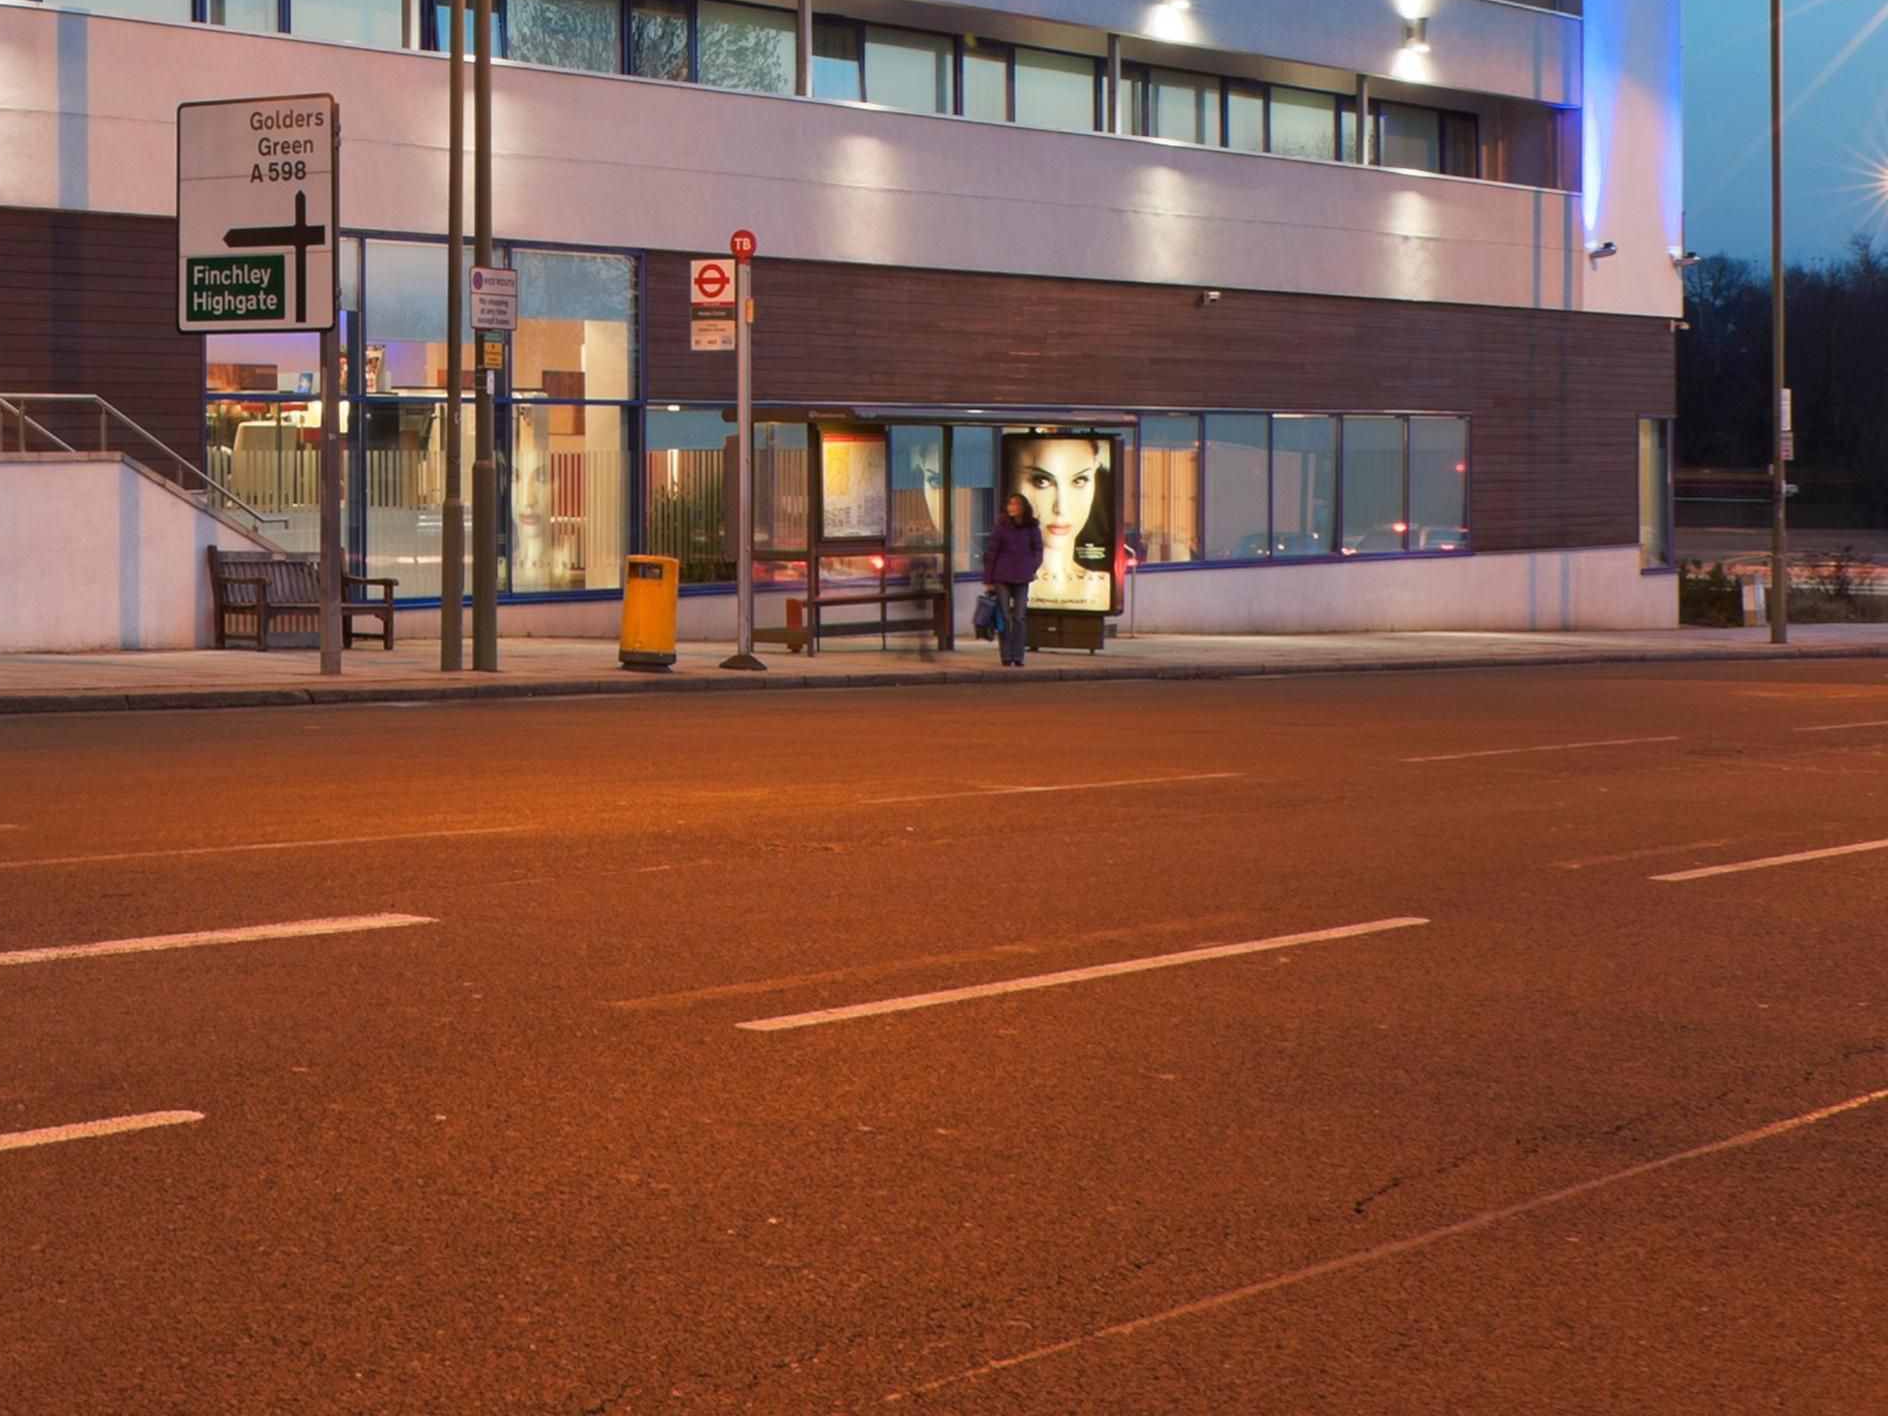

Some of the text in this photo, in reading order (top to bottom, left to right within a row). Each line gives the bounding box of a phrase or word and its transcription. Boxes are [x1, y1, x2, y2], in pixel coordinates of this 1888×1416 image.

[250, 111, 324, 130] Golders
[258, 137, 314, 157] Green
[734, 237, 752, 251] TB
[193, 264, 272, 288] Finchley
[193, 291, 278, 315] Highgate
